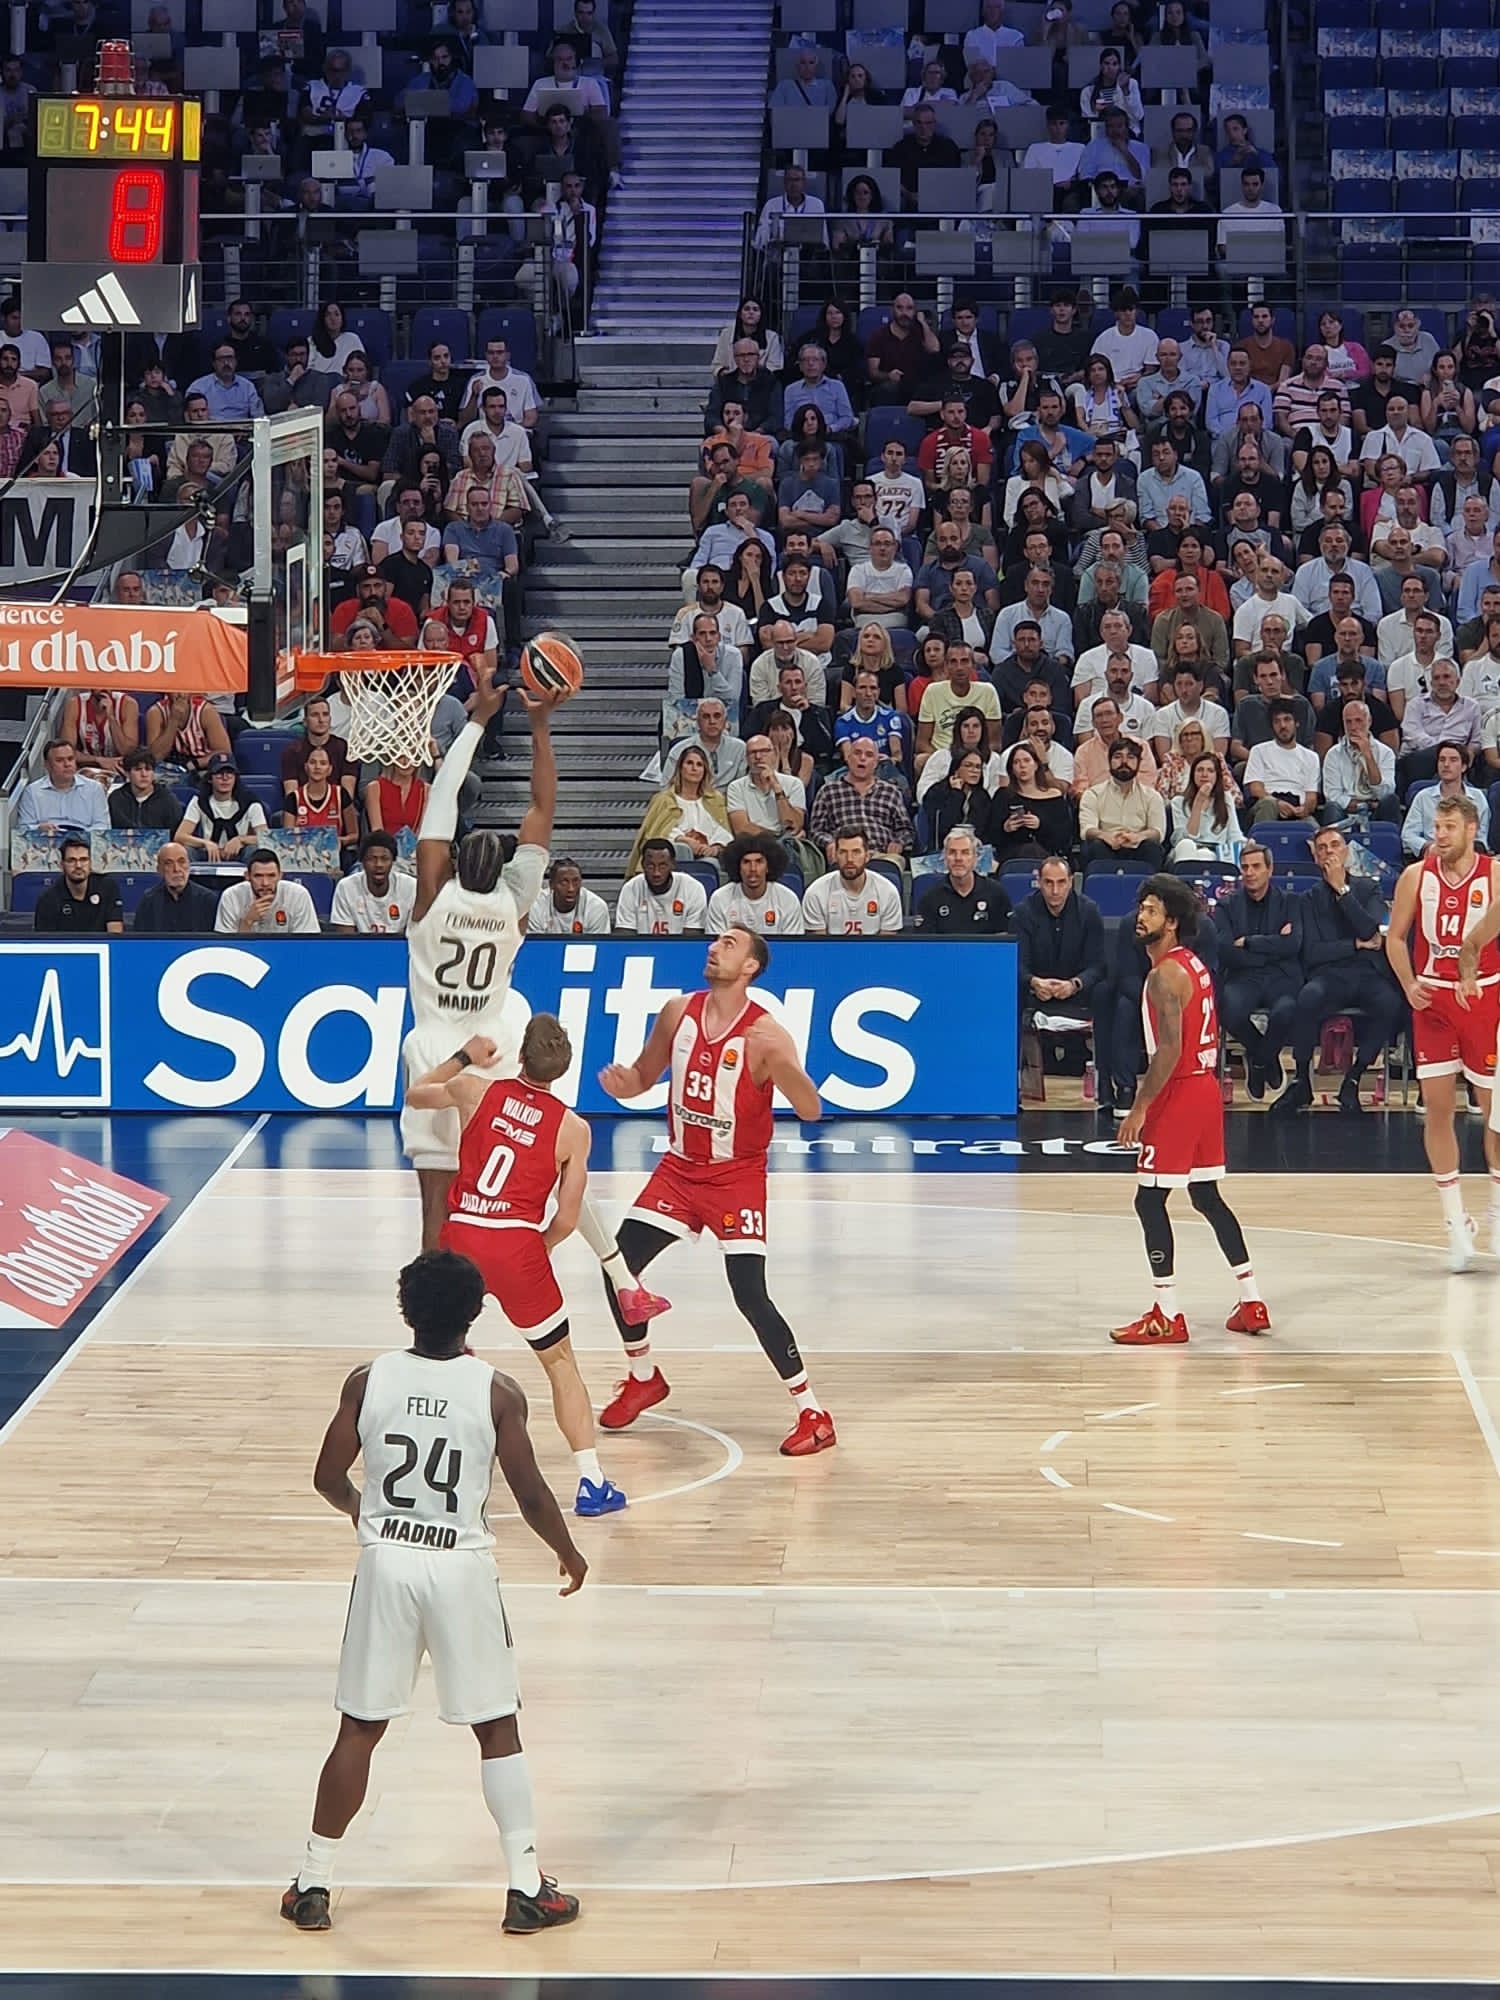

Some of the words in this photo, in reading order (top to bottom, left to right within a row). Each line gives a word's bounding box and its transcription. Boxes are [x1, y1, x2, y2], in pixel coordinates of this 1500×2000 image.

[75, 104, 173, 152] 7:44
[109, 170, 164, 263] 8
[882, 500, 906, 518] 77
[445, 911, 506, 933] FERNANDO
[1440, 914, 1460, 936] 14
[434, 935, 497, 991] 20
[686, 1070, 713, 1101] 33
[502, 1096, 544, 1128] WALKUP
[477, 1144, 516, 1198] 0
[739, 1207, 764, 1237] 33
[406, 1396, 449, 1419] FELIZ
[382, 1433, 463, 1513] 24
[380, 1518, 458, 1549] MADRID
